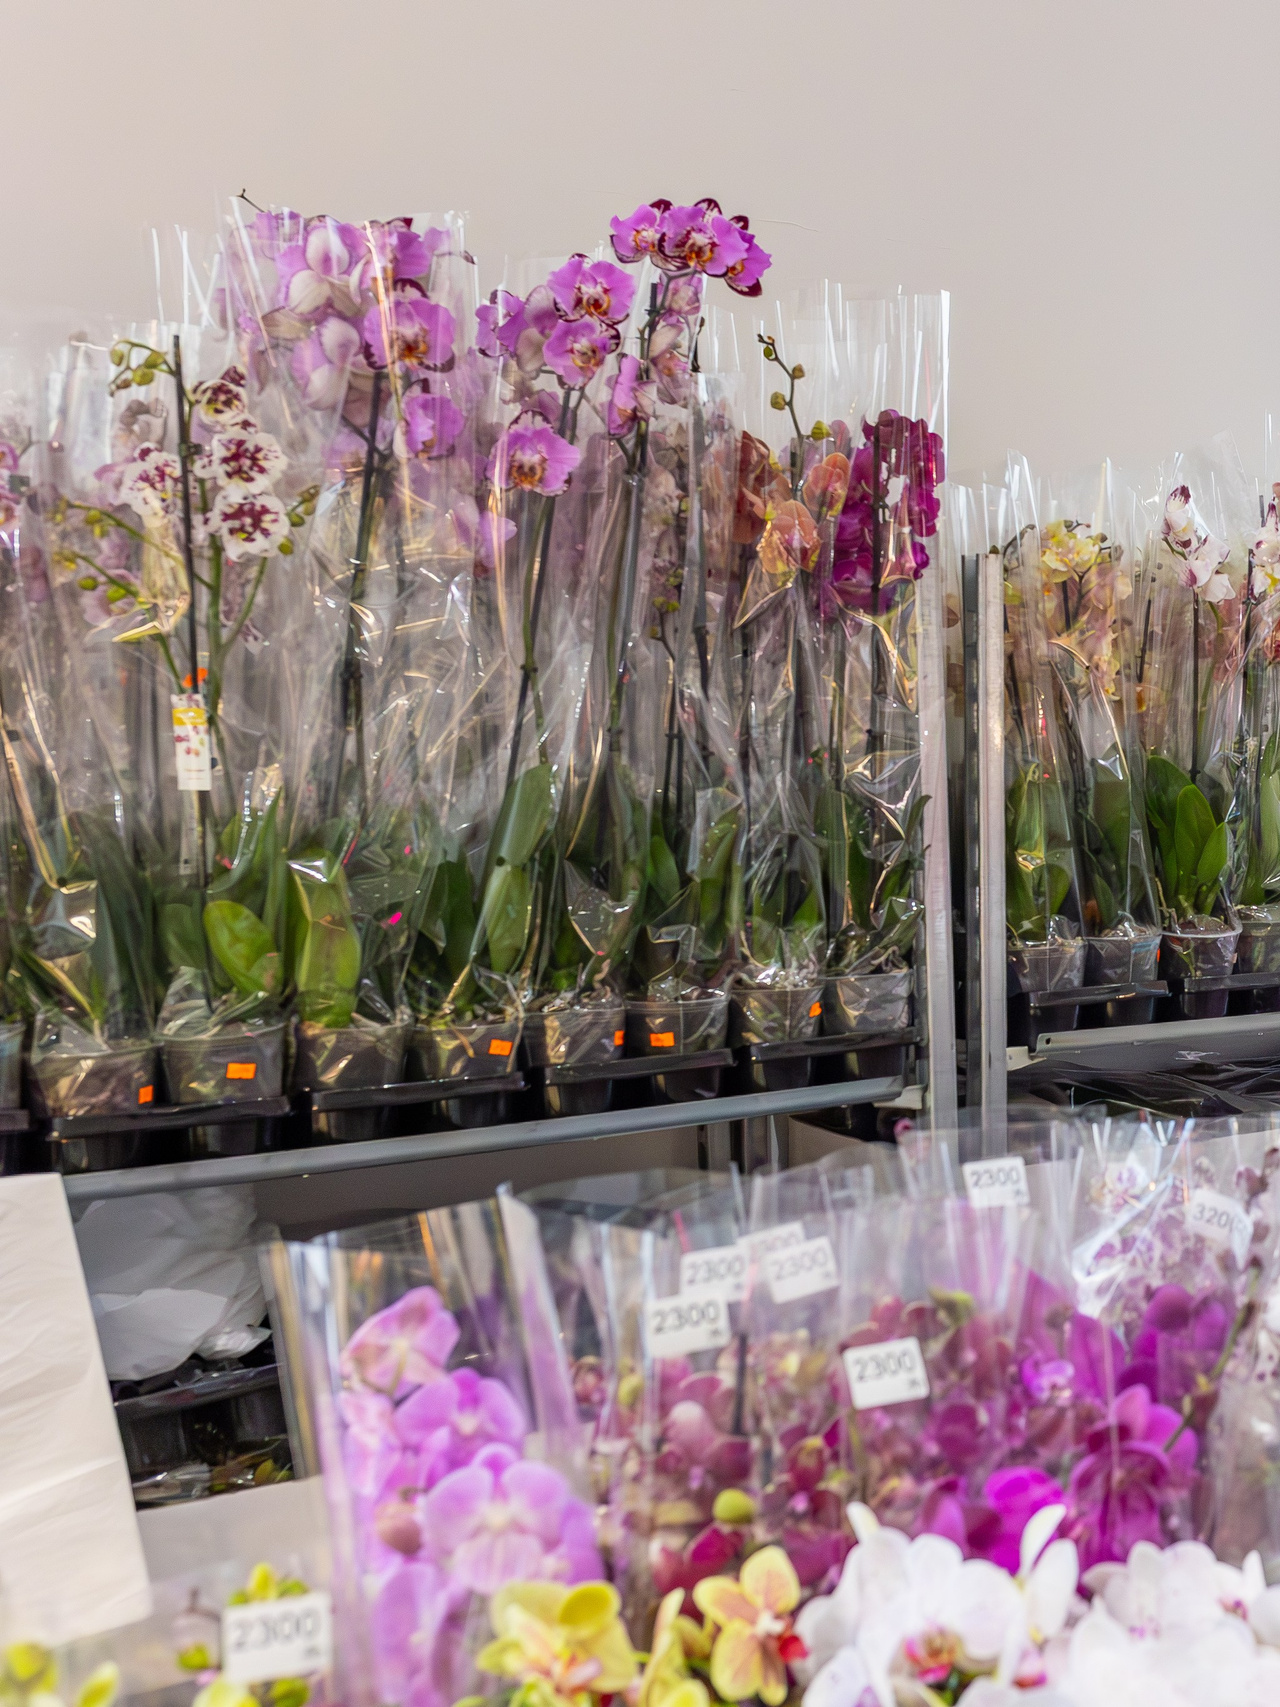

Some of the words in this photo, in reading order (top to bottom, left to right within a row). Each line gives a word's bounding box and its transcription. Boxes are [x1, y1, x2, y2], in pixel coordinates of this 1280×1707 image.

[970, 1167, 1020, 1188] 2300
[686, 1254, 746, 1286] 2300
[768, 1245, 828, 1281] 2300
[652, 1299, 720, 1335] 2300
[854, 1350, 916, 1382] 2300
[231, 1607, 321, 1653] 2300
